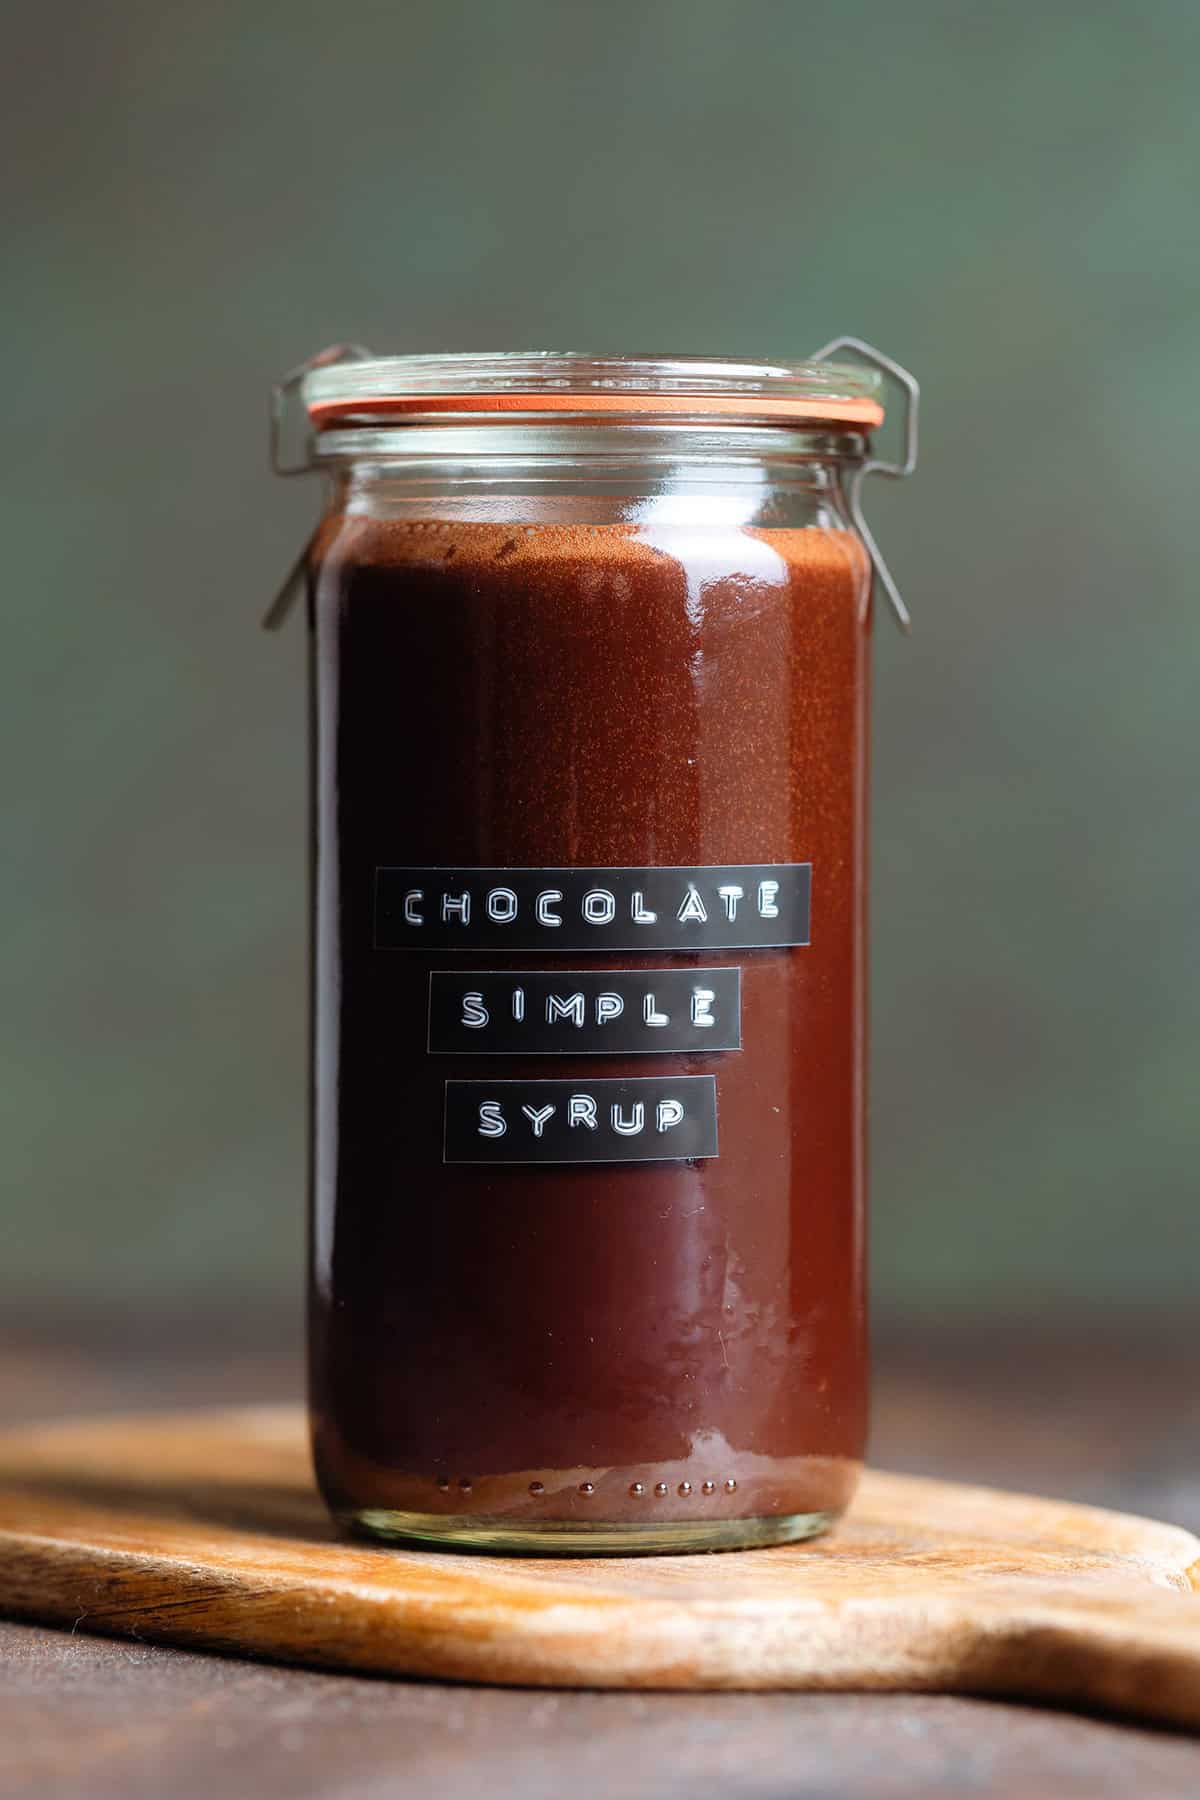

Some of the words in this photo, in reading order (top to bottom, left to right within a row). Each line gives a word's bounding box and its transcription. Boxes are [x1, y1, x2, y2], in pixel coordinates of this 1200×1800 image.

[403, 880, 780, 927] CHOCOLATE
[460, 986, 716, 1029] SIMPLE
[477, 1094, 686, 1138] SYRUP
